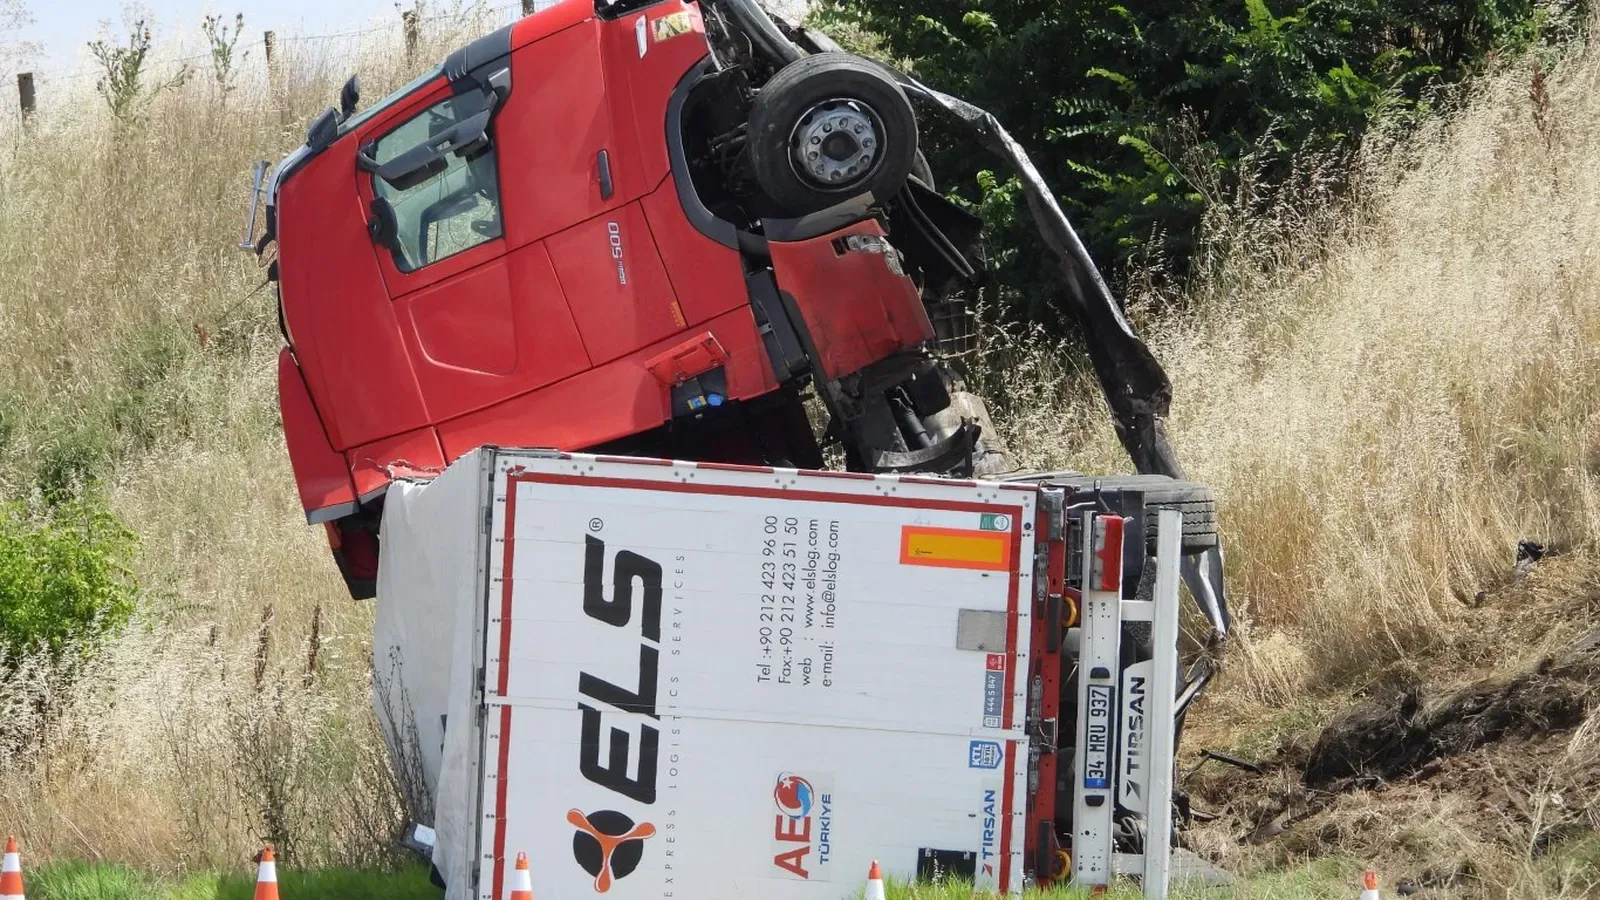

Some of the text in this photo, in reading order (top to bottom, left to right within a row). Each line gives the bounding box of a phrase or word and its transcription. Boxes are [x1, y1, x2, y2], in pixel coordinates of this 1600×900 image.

[607, 222, 623, 258] 500
[765, 515, 778, 534] 00
[785, 517, 798, 535] 50
[762, 539, 776, 557] 96
[783, 542, 797, 558] 51
[761, 561, 776, 590] 423
[782, 563, 796, 591] 423
[801, 519, 820, 628] www.elslog.com
[760, 594, 775, 622] 212
[781, 595, 796, 622] 212
[818, 520, 840, 687] e-mail: info@elslog.com
[577, 533, 663, 804] ELS
[756, 664, 771, 682] Tel
[797, 657, 812, 686] web
[988, 675, 996, 689] 847
[987, 697, 995, 713] 444
[664, 555, 685, 898] EXPRESS LOGISTICS SERVICES
[1088, 689, 1107, 778] 34 MRU 937
[1126, 677, 1145, 775] TIRSAN
[972, 744, 981, 766] KTL
[818, 794, 831, 865] TÜRKİYE
[982, 790, 995, 860] TIRSAN
